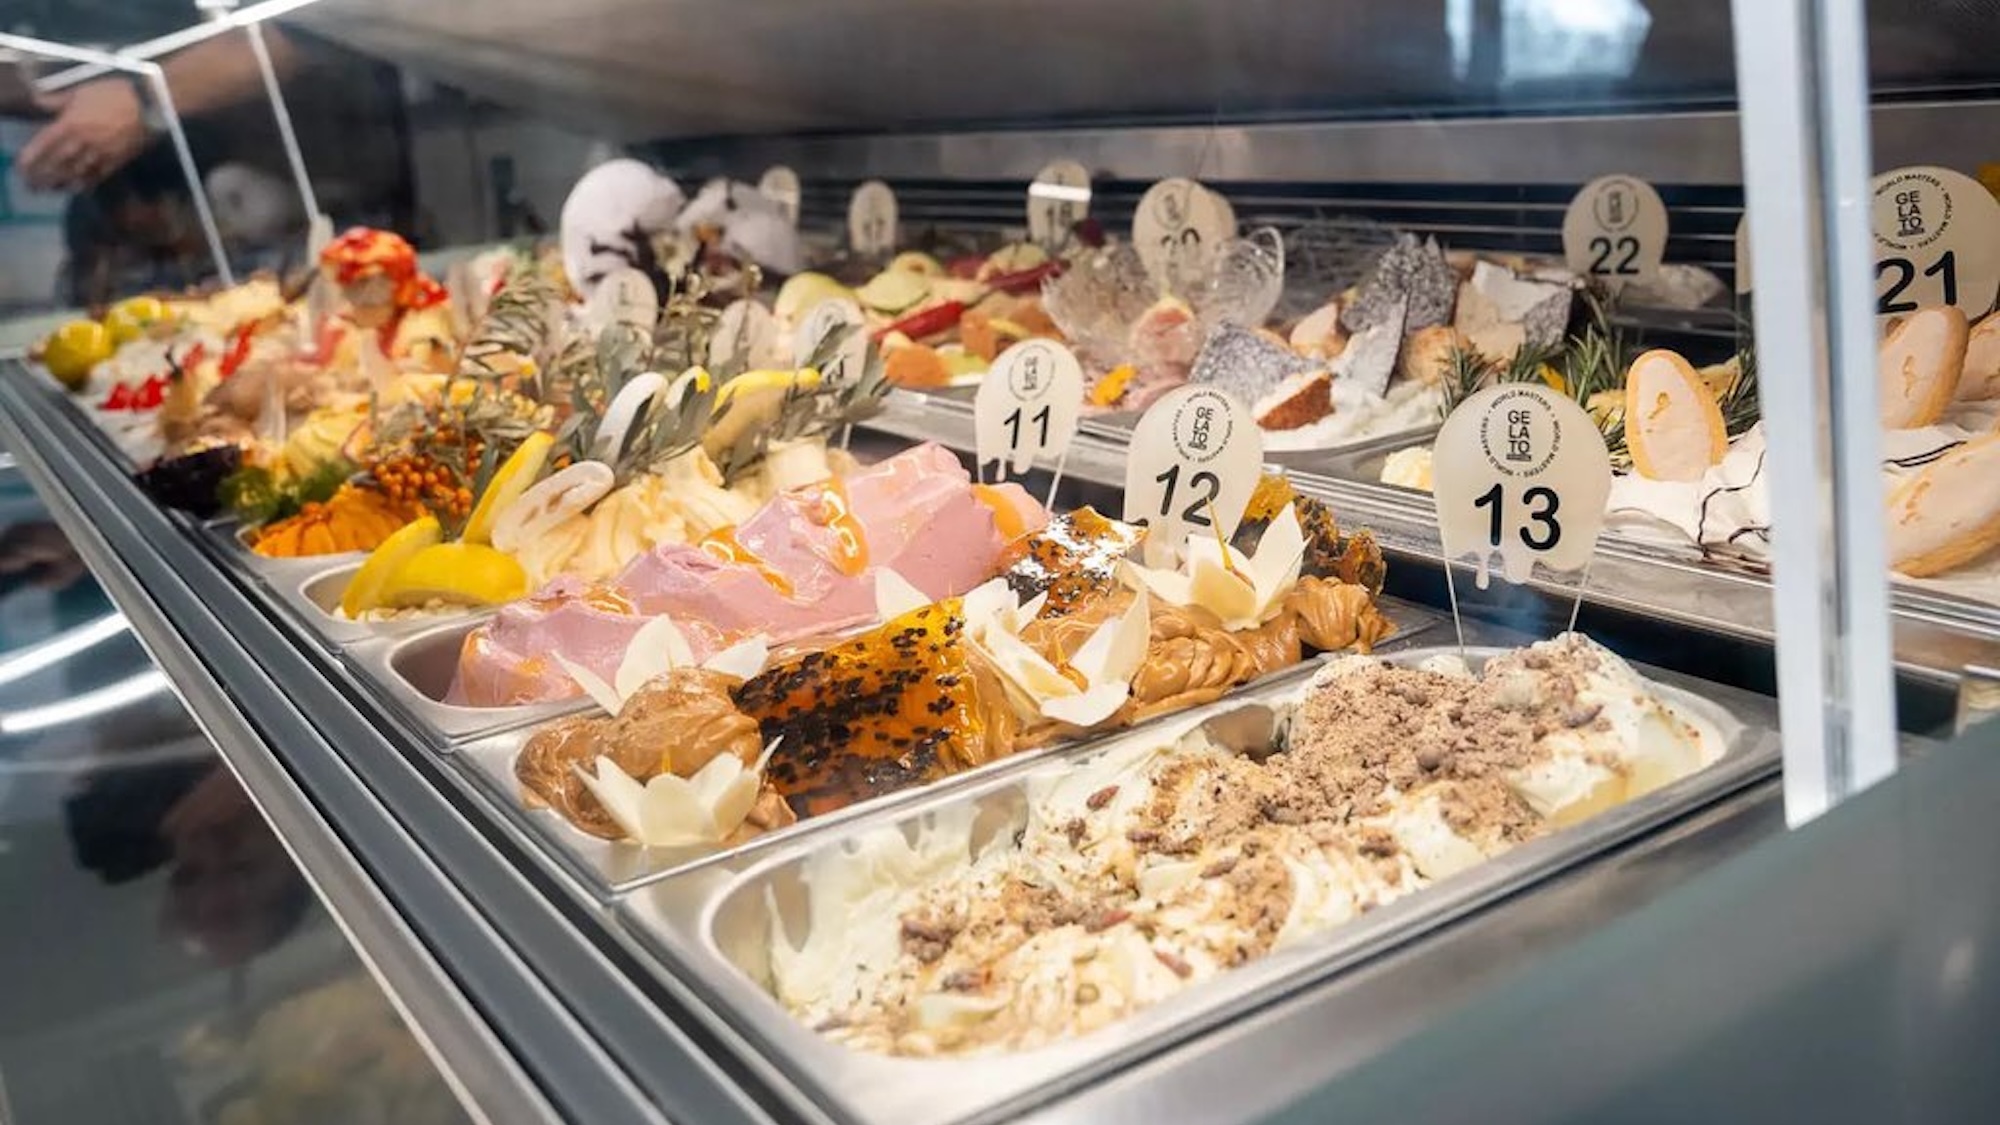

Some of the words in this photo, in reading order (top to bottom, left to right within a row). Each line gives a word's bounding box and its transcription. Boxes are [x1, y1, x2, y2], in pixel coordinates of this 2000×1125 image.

[1895, 190, 1921, 205] GE
[1897, 204, 1921, 218] LA
[1897, 216, 1922, 232] TO
[1589, 236, 1640, 274] 22
[1875, 250, 1956, 314] 21
[1195, 406, 1215, 421] GE
[1507, 410, 1531, 425] GE
[1004, 405, 1050, 450] 11
[1193, 419, 1210, 433] LA
[1508, 424, 1530, 440] LA
[1192, 430, 1208, 444] TO
[1507, 440, 1531, 455] TO
[1156, 464, 1220, 526] 12
[1475, 483, 1561, 551] 13
